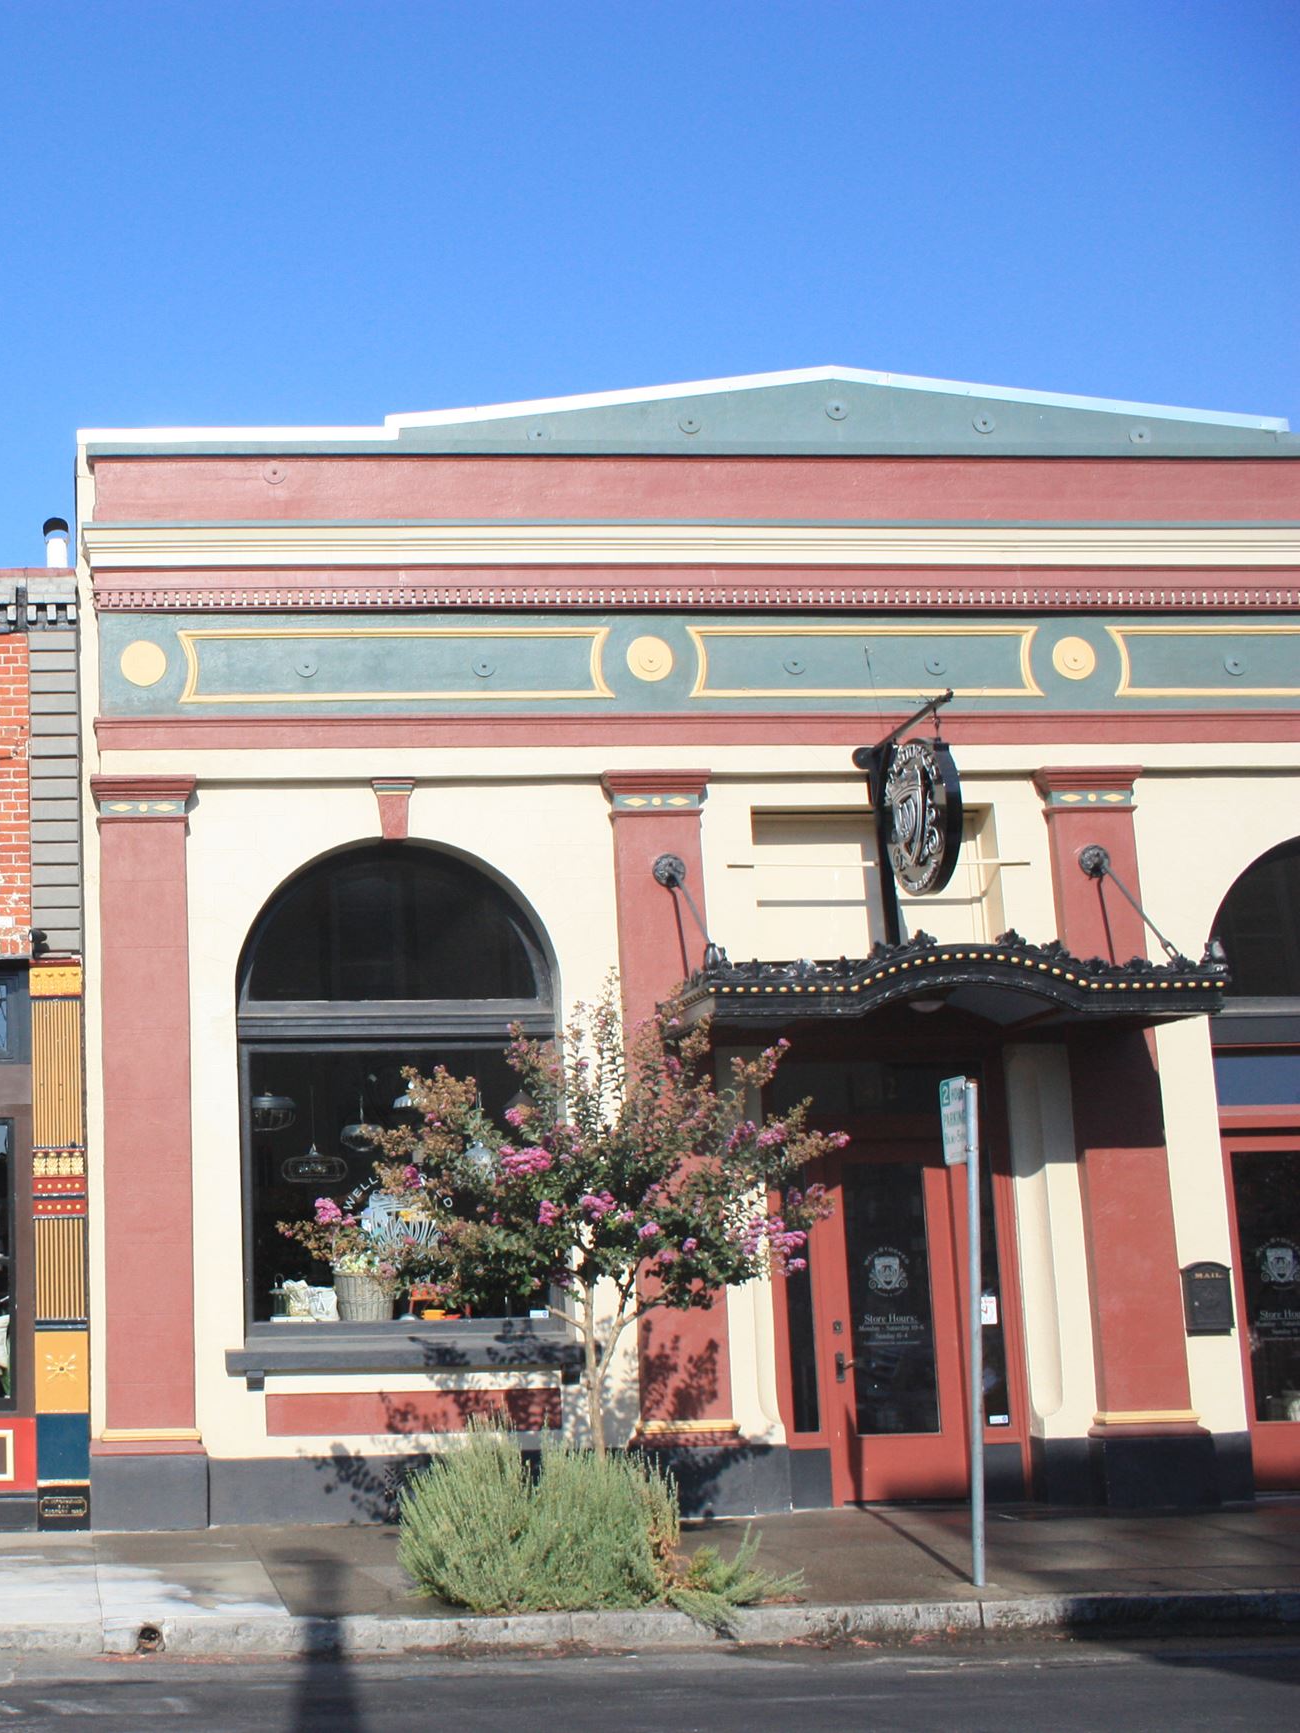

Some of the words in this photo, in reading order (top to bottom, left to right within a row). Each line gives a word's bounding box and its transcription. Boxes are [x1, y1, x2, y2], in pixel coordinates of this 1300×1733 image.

[942, 1086, 950, 1104] 2
[342, 1175, 380, 1211] WELL
[1194, 1272, 1223, 1280] MAIL
[864, 1313, 887, 1323] Store
[888, 1312, 917, 1323] Hours:
